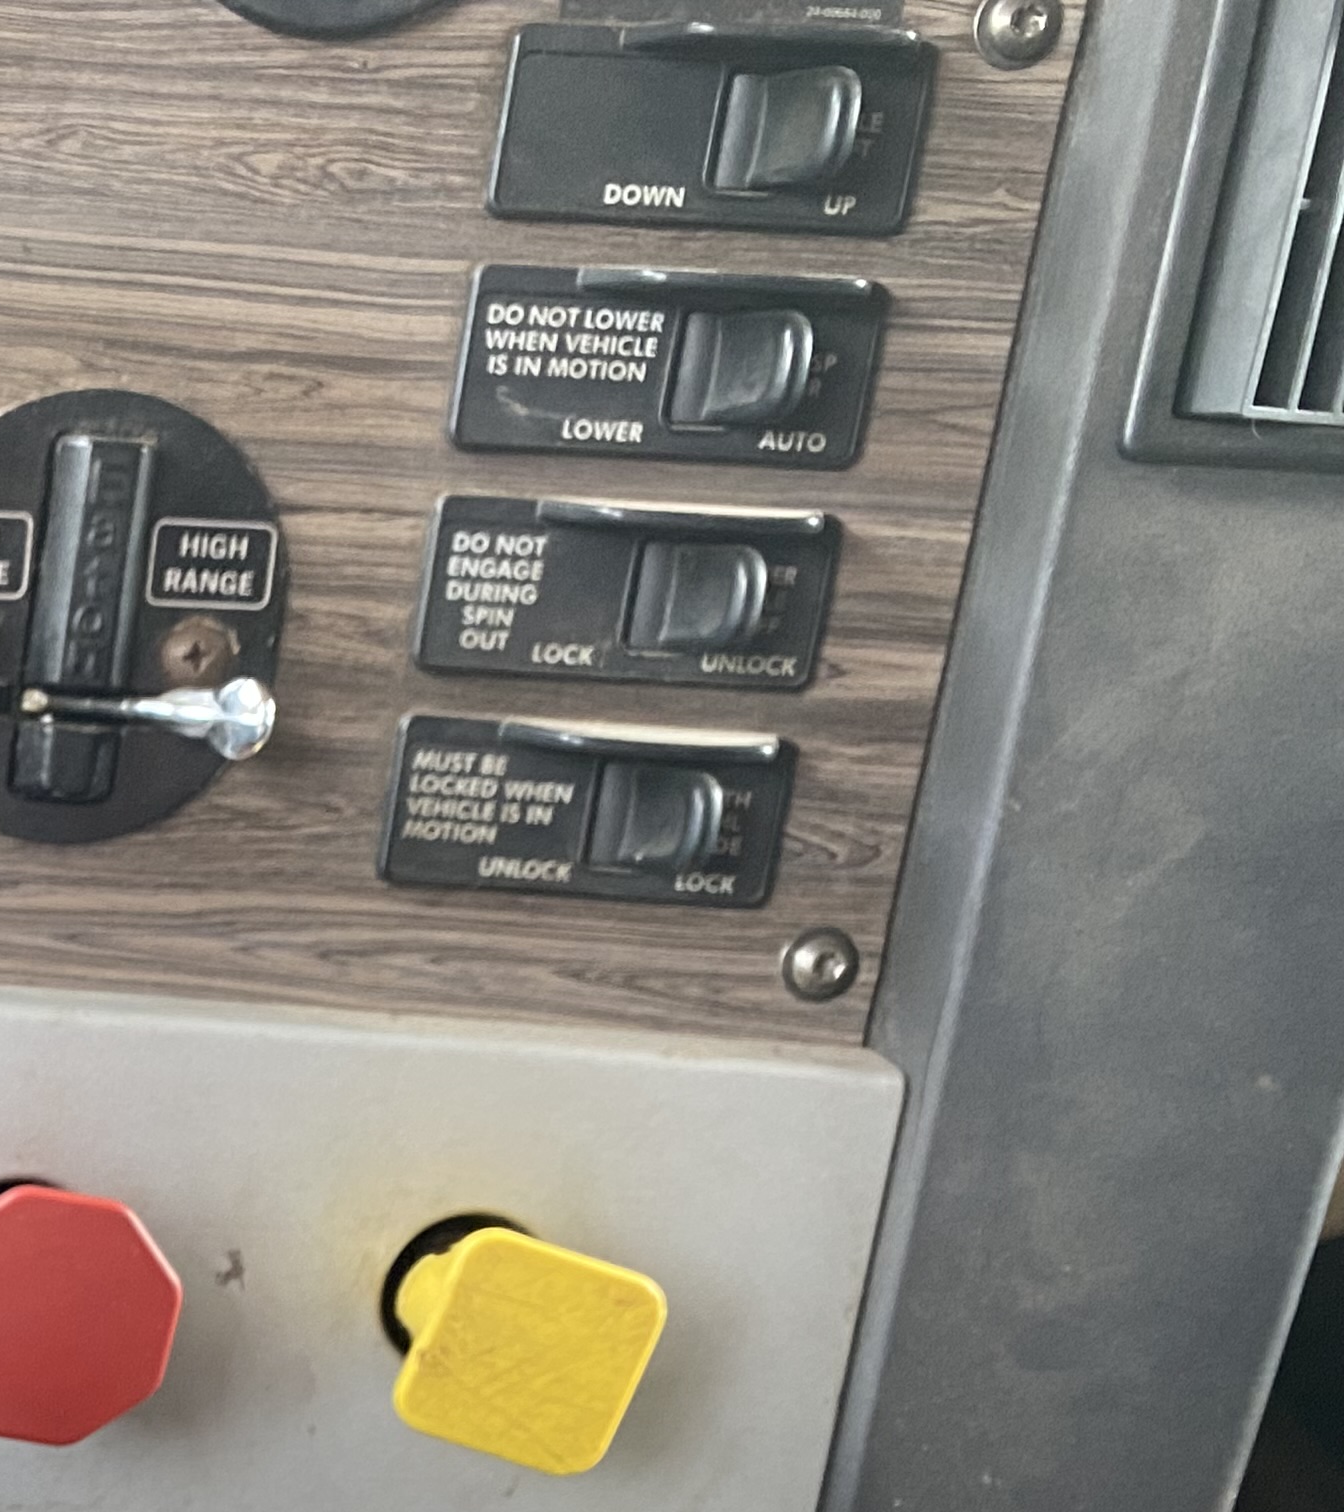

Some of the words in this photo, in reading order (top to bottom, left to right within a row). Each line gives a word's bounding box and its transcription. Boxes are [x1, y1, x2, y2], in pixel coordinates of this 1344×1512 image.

[603, 183, 685, 208] DOWN
[823, 195, 857, 216] UP
[487, 303, 525, 326] DO
[528, 305, 581, 328] NOT
[583, 307, 665, 333] LOWER
[485, 327, 559, 353] WHEN
[564, 332, 658, 358] VEHICLE
[486, 353, 509, 376] IS
[514, 355, 542, 377] IN
[547, 357, 648, 383] MOTION
[561, 418, 645, 443] LOWER
[757, 429, 827, 453] AUTO
[179, 533, 249, 560] HIGH
[452, 531, 490, 553] DO
[495, 533, 549, 557] NOT
[163, 566, 254, 597] RANGE
[447, 555, 544, 581] ENGAGE
[446, 579, 537, 605] DURING
[462, 603, 515, 627] SPIN
[459, 627, 510, 650] OUT
[531, 642, 594, 666] LOCK
[700, 653, 797, 677] UNLOCK
[413, 750, 478, 774] MUST
[480, 753, 509, 776] BE
[409, 773, 499, 799] LOCKED
[504, 779, 575, 805] WHEN
[406, 797, 497, 822] VEHICLE
[500, 801, 521, 824] IS
[525, 803, 554, 826] IN
[401, 819, 498, 845] MOTION
[478, 856, 574, 883] UNLOCK
[674, 872, 736, 895] LOCK
